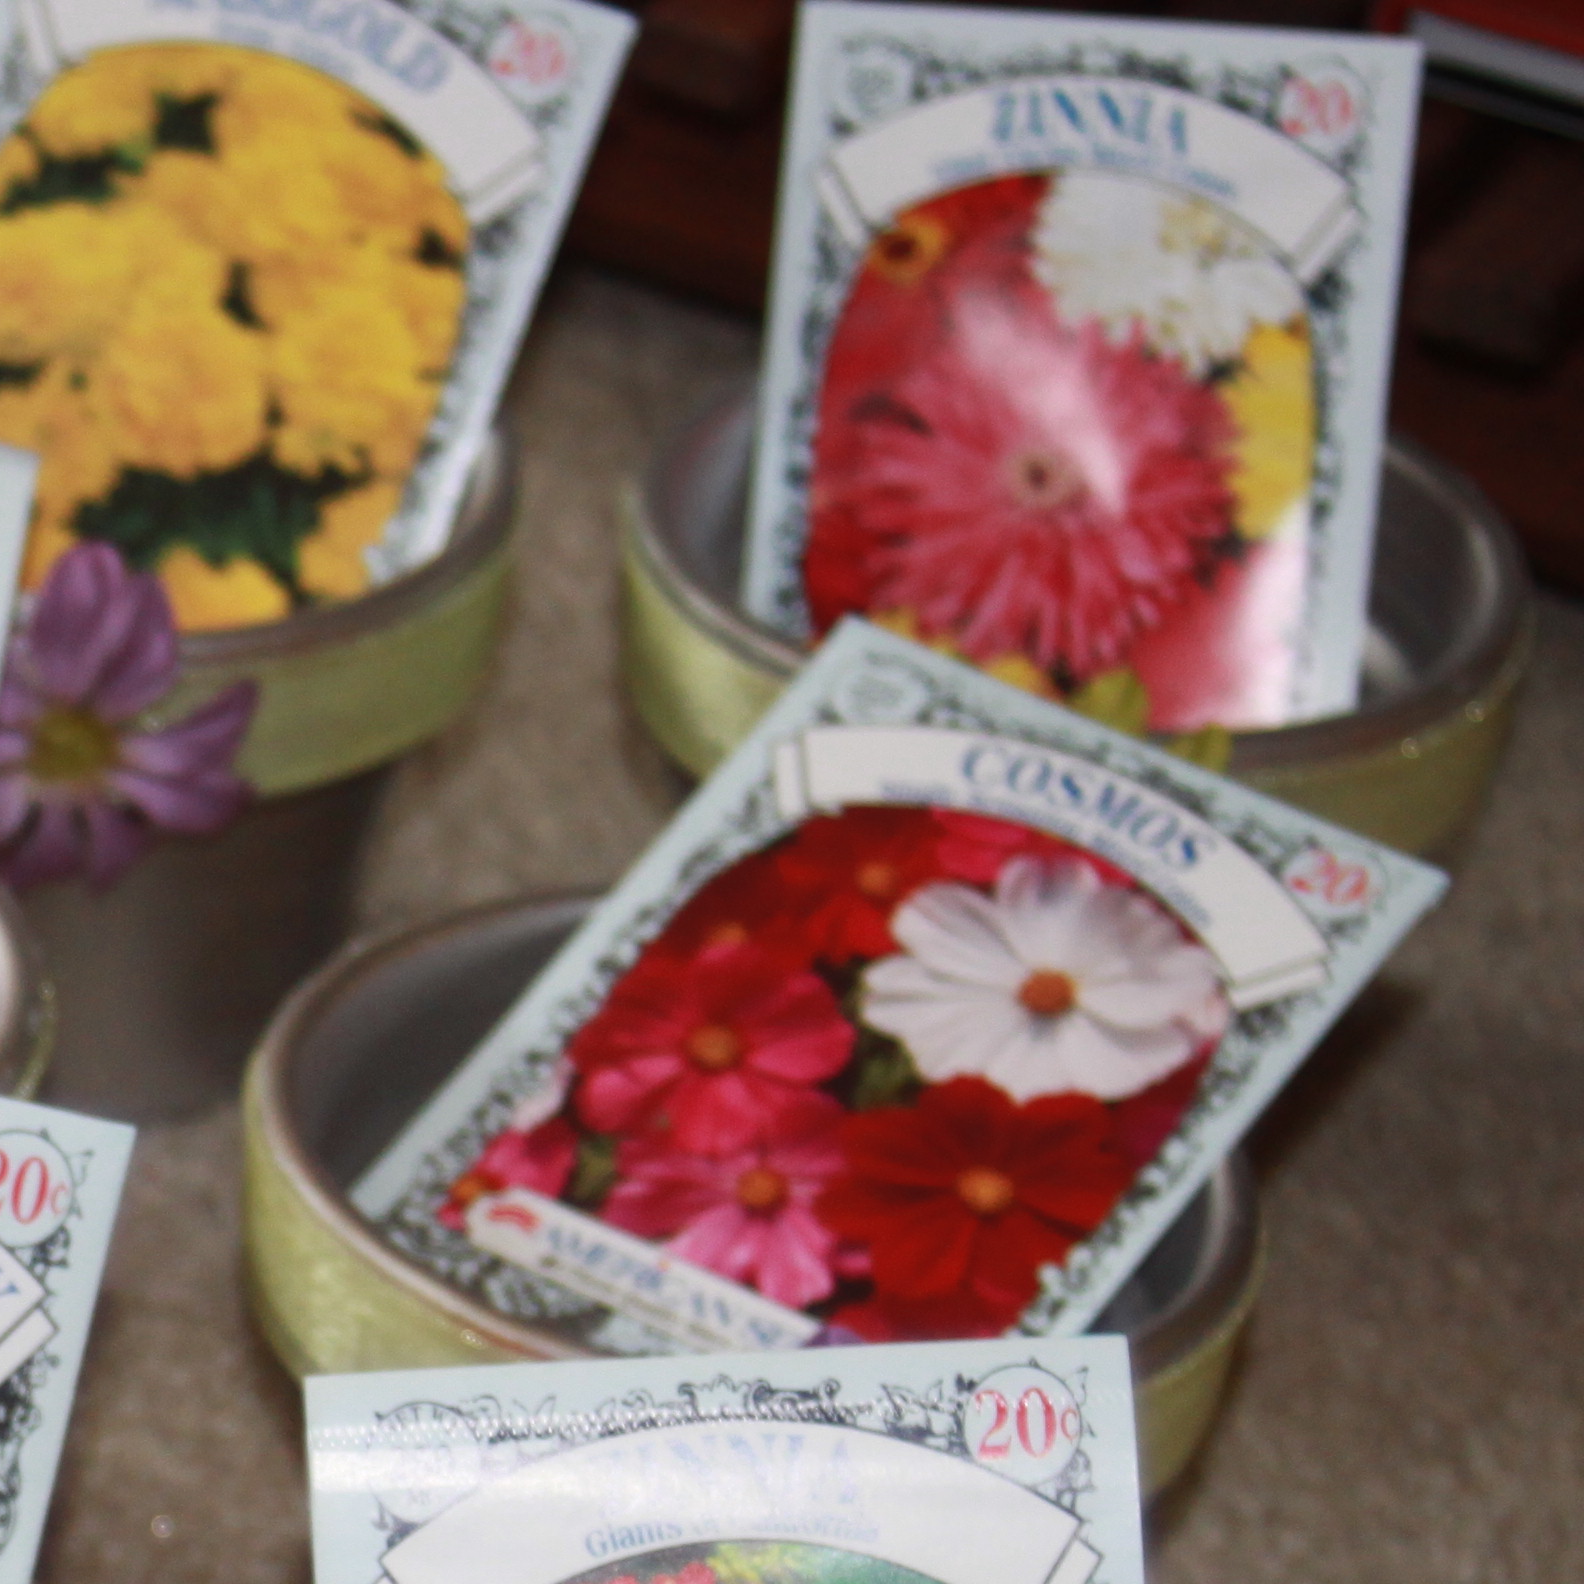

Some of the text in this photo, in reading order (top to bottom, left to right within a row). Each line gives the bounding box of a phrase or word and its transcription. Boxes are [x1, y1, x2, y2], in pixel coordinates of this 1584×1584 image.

[992, 86, 1189, 154] ZINNIA
[962, 742, 1210, 870] COSMOS
[583, 1520, 684, 1559] Giants
